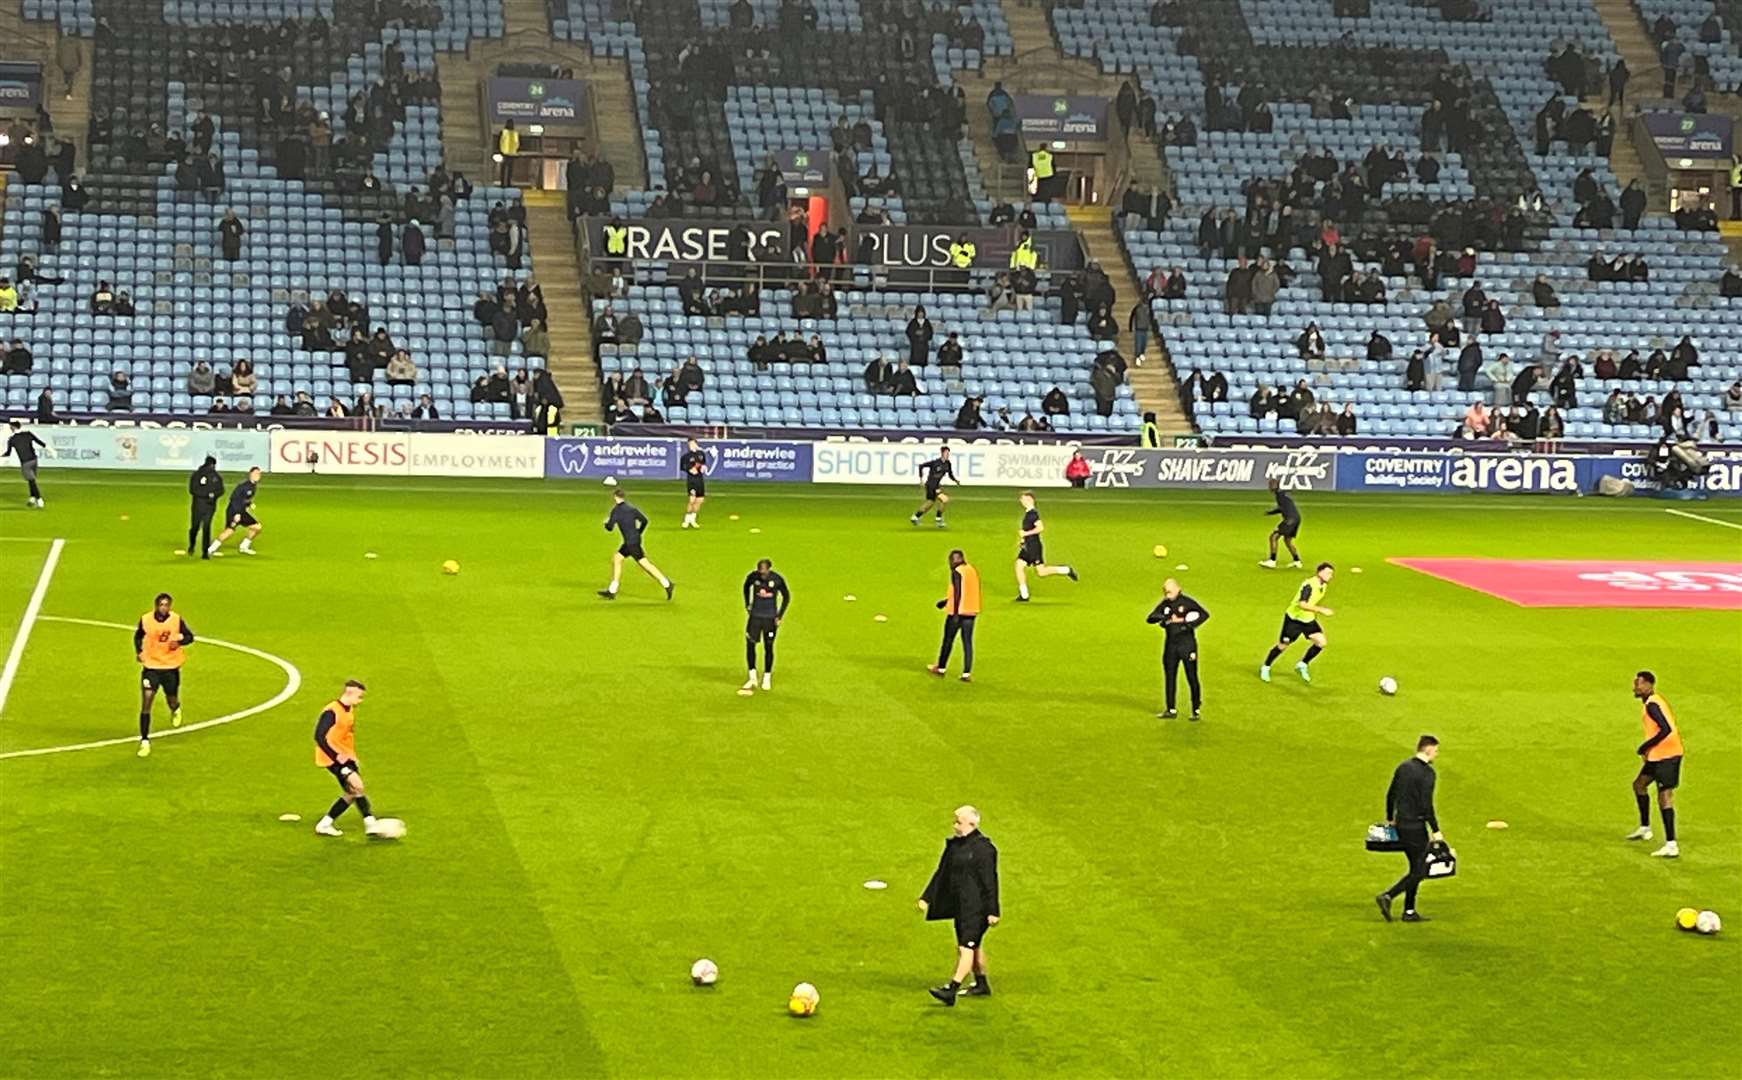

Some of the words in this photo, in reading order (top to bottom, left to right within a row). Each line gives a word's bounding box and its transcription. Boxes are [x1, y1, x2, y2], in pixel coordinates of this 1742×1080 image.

[530, 84, 543, 95] 24
[540, 106, 575, 117] arena
[1063, 122, 1097, 133] arena
[1681, 120, 1694, 130] 27
[1689, 140, 1722, 151] arena
[280, 440, 407, 465] GENESIS
[412, 453, 537, 470] EMPLOYMENT
[593, 442, 668, 457] andrewlee
[723, 445, 796, 460] andrewlee
[593, 457, 626, 466] dental
[627, 458, 667, 468] practice
[723, 459, 755, 469] dental
[756, 461, 796, 471] practice
[817, 450, 985, 478] SHOTCRTE
[996, 467, 1042, 480] POOLS
[1158, 457, 1255, 482] SHAVE.COM
[1365, 457, 1443, 474] COVENTRY
[1450, 457, 1578, 491] arena
[1364, 473, 1406, 487] Building
[1406, 473, 1443, 488] Society
